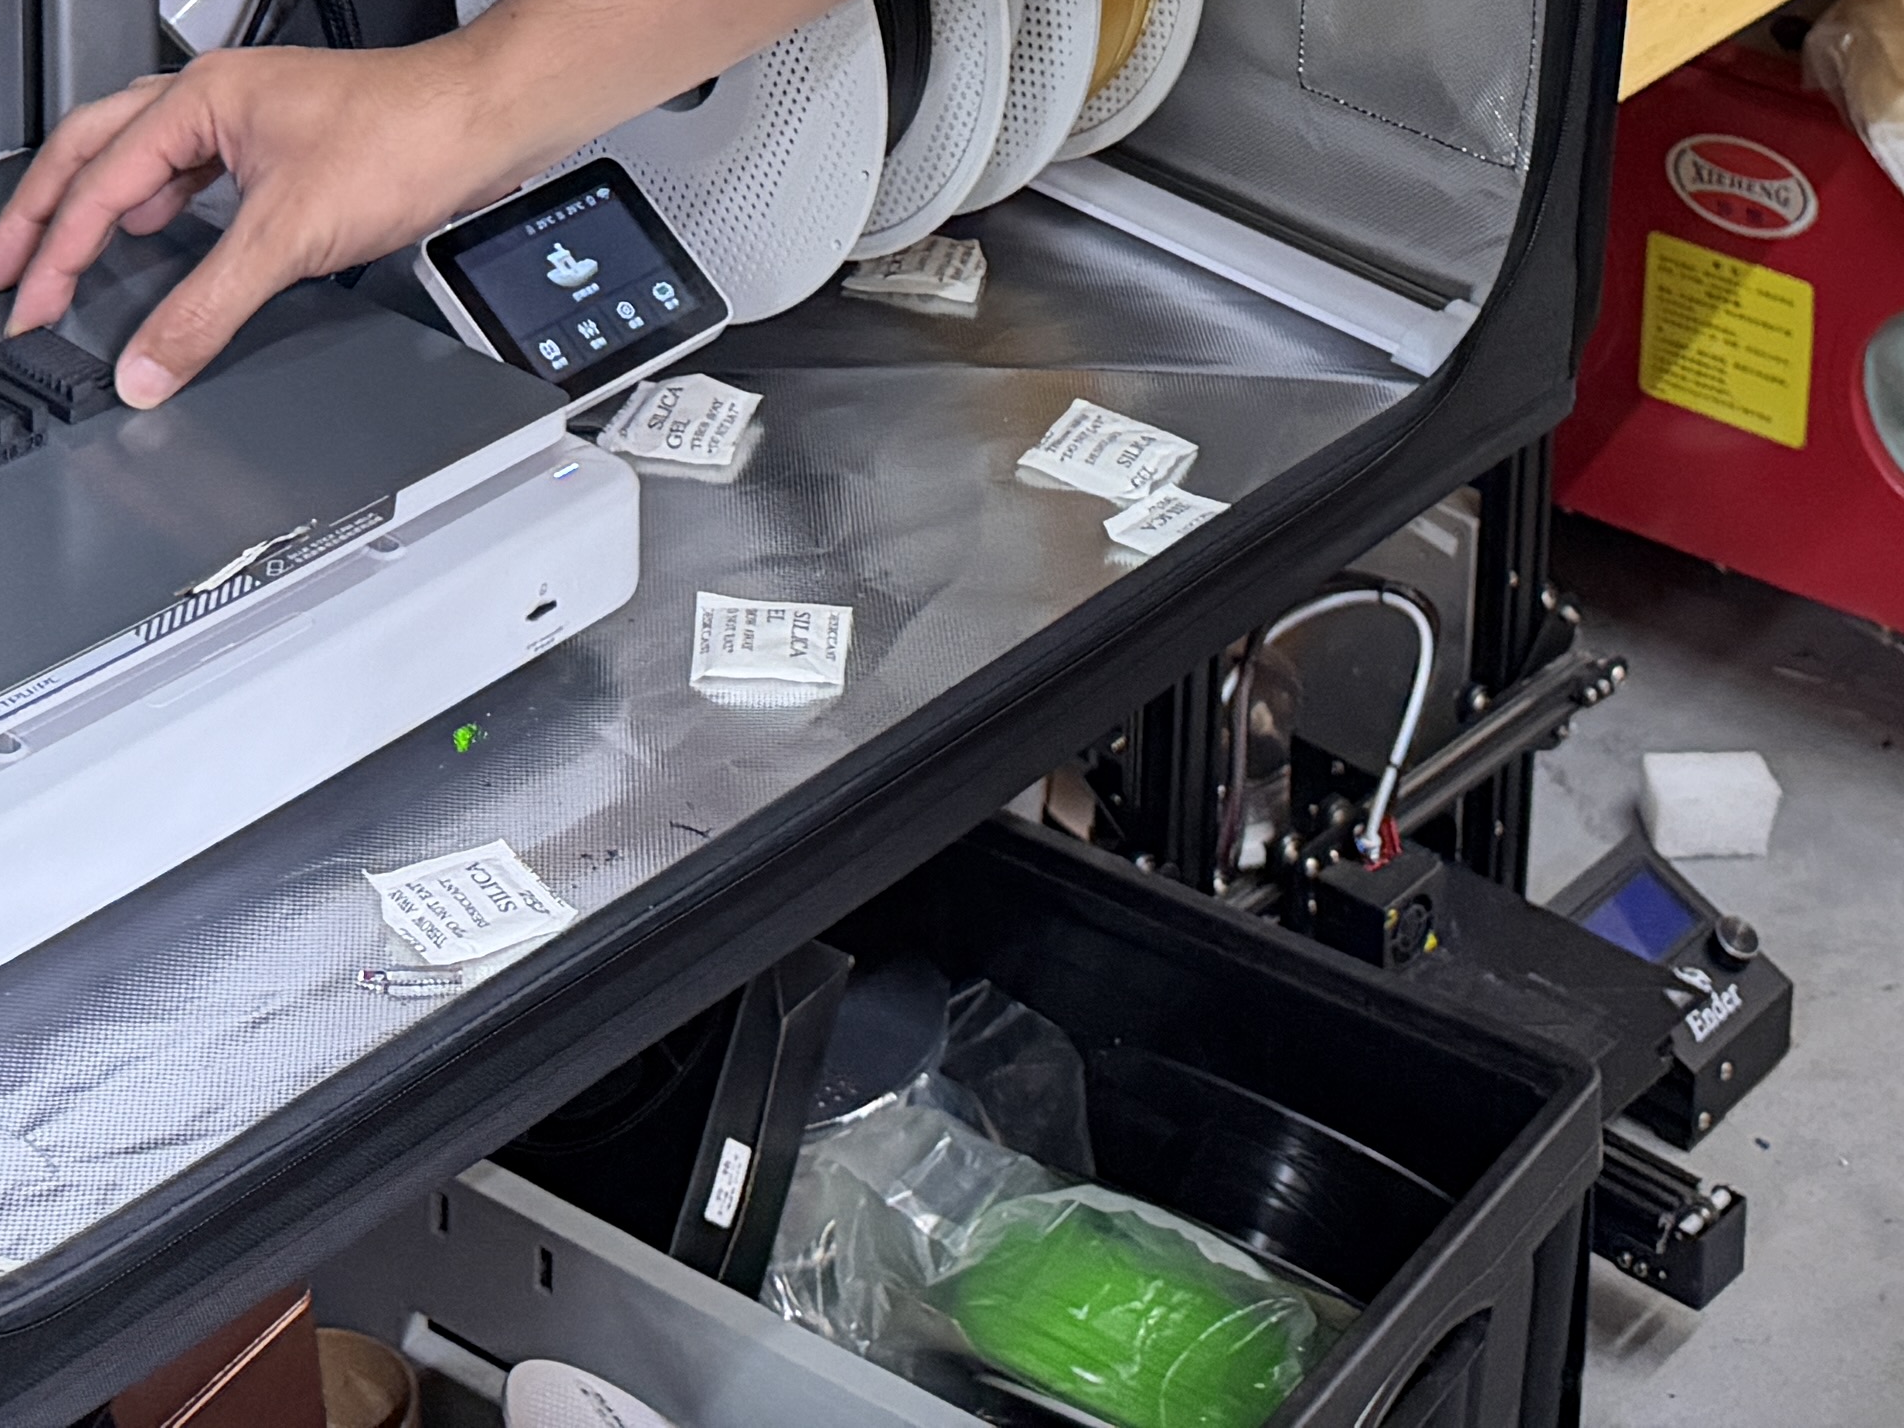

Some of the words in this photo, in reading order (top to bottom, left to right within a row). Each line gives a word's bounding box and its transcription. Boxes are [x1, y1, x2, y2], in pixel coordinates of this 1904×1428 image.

[647, 387, 684, 431] SILICA
[666, 419, 691, 450] GEL
[789, 610, 812, 658] SILICA
[388, 889, 420, 914] AWAY
[438, 879, 491, 928] DESICCANT
[465, 862, 518, 913] SILICA
[426, 901, 452, 920] NOT
[412, 917, 448, 949] THROW
[1685, 983, 1743, 1042] Ender
